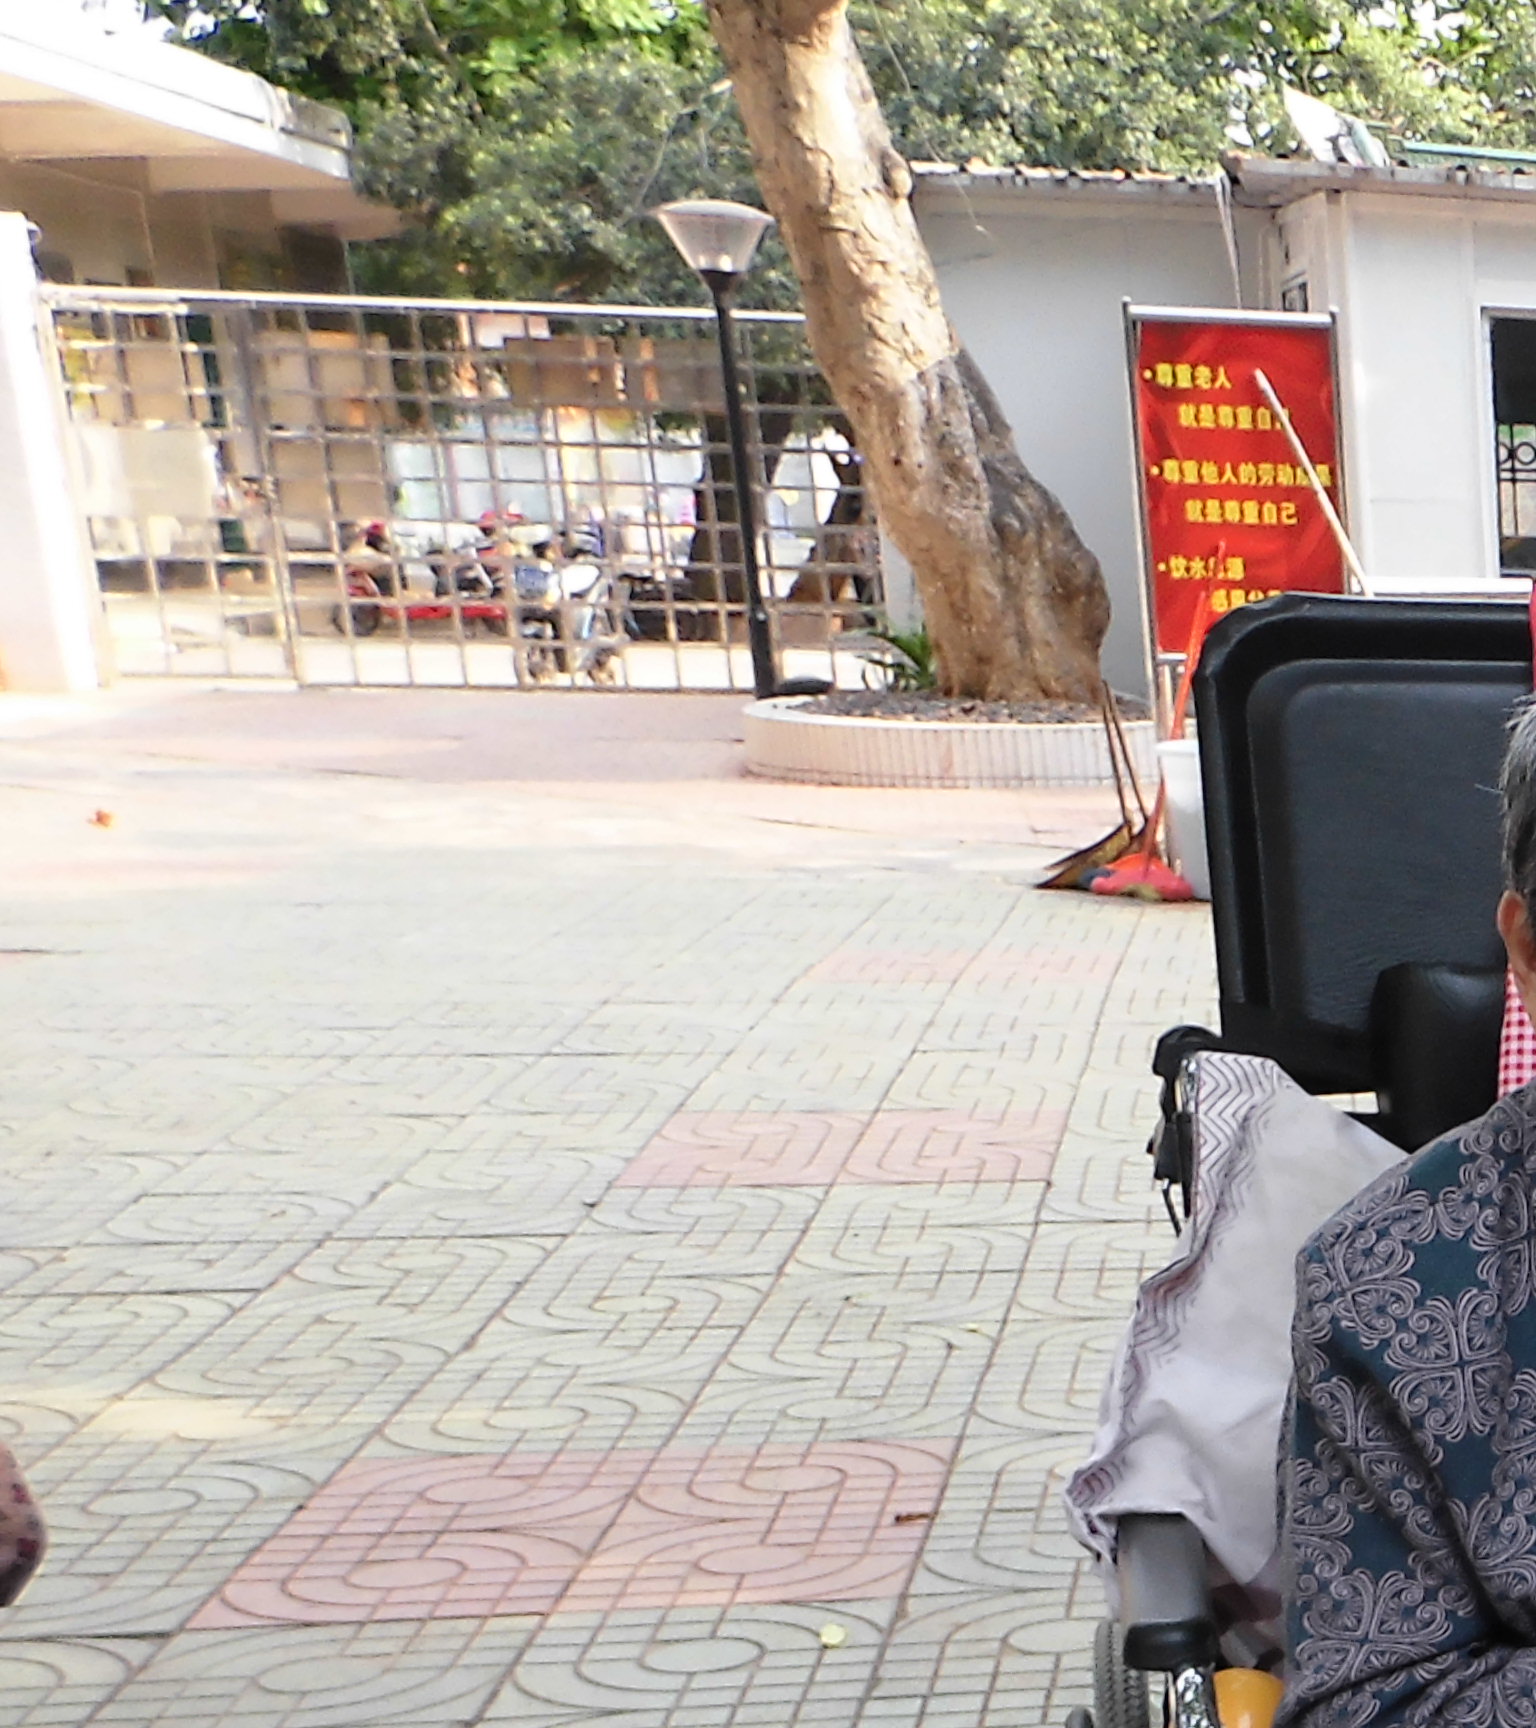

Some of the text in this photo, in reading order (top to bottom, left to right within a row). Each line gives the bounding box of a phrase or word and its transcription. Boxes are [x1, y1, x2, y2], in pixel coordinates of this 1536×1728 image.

[1155, 362, 1232, 390] 尊重老人
[1185, 498, 1298, 525] 就是尊重自己
